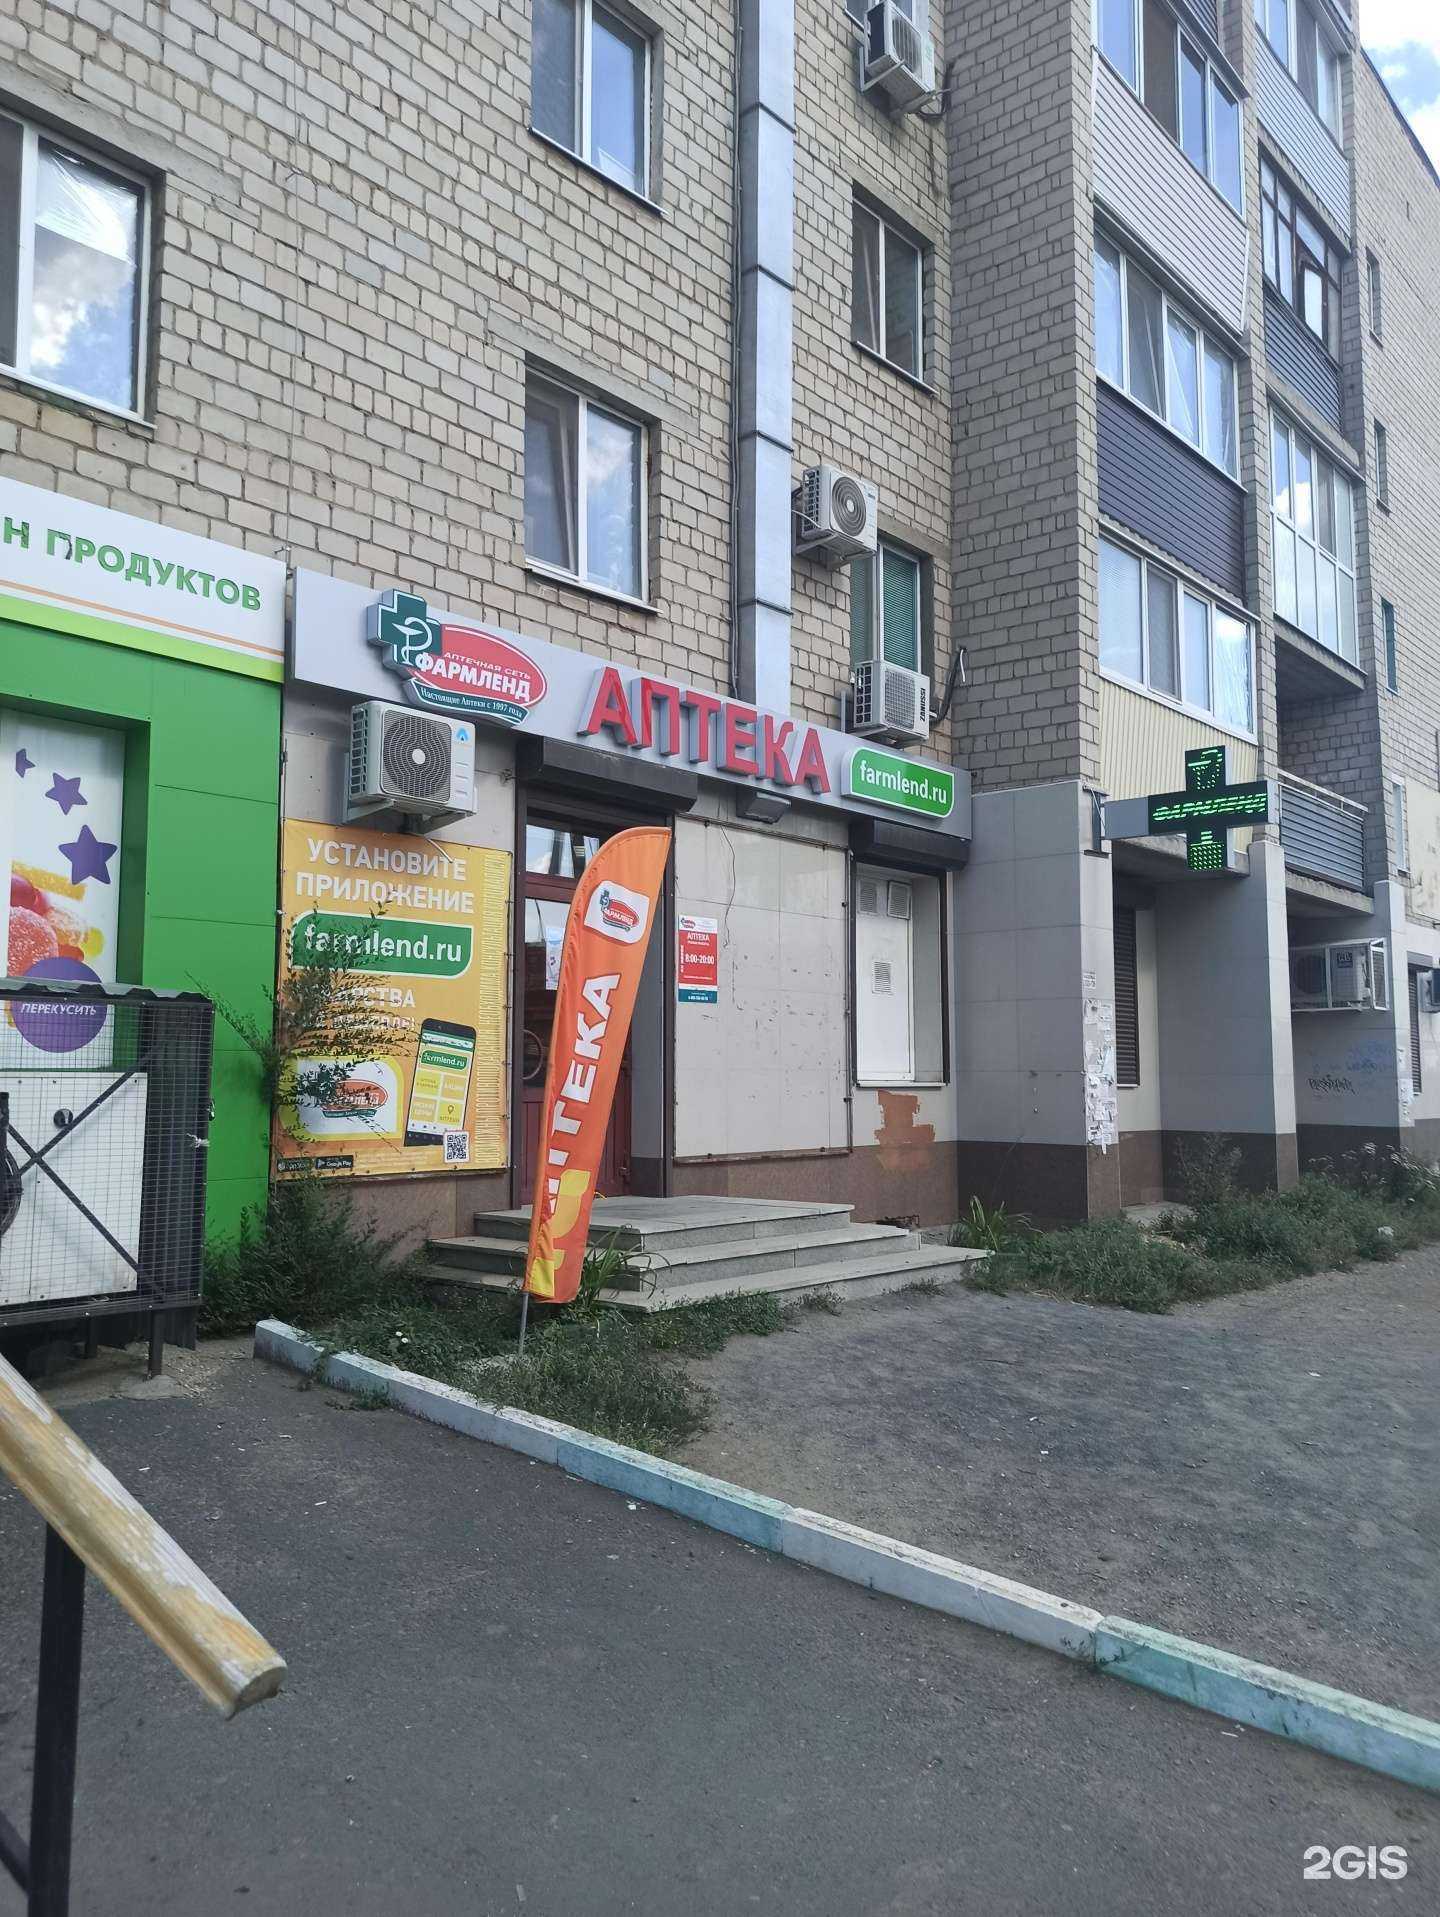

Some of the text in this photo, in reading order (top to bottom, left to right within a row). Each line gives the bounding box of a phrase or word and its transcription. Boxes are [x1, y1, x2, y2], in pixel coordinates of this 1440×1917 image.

[46, 528, 262, 611] ПРОДУКТОВ
[415, 652, 531, 703] ФАРМЛЕНД
[443, 651, 531, 680] АПТЕЧНАЯ СЕТЬ
[420, 687, 460, 705] Настоящие
[919, 687, 927, 723] ZANUSSI
[582, 666, 831, 794] АПТЕКА
[859, 759, 947, 805] farmlend.ru
[306, 838, 467, 881] УСТАНОВИТЕ
[296, 872, 475, 914] ПРИЛОЖЕНИЕ
[304, 924, 462, 962] farmlend.ru
[687, 932, 710, 941] АПТЕКА
[20, 1002, 97, 1016] ПЕРЕКУСИТЬ
